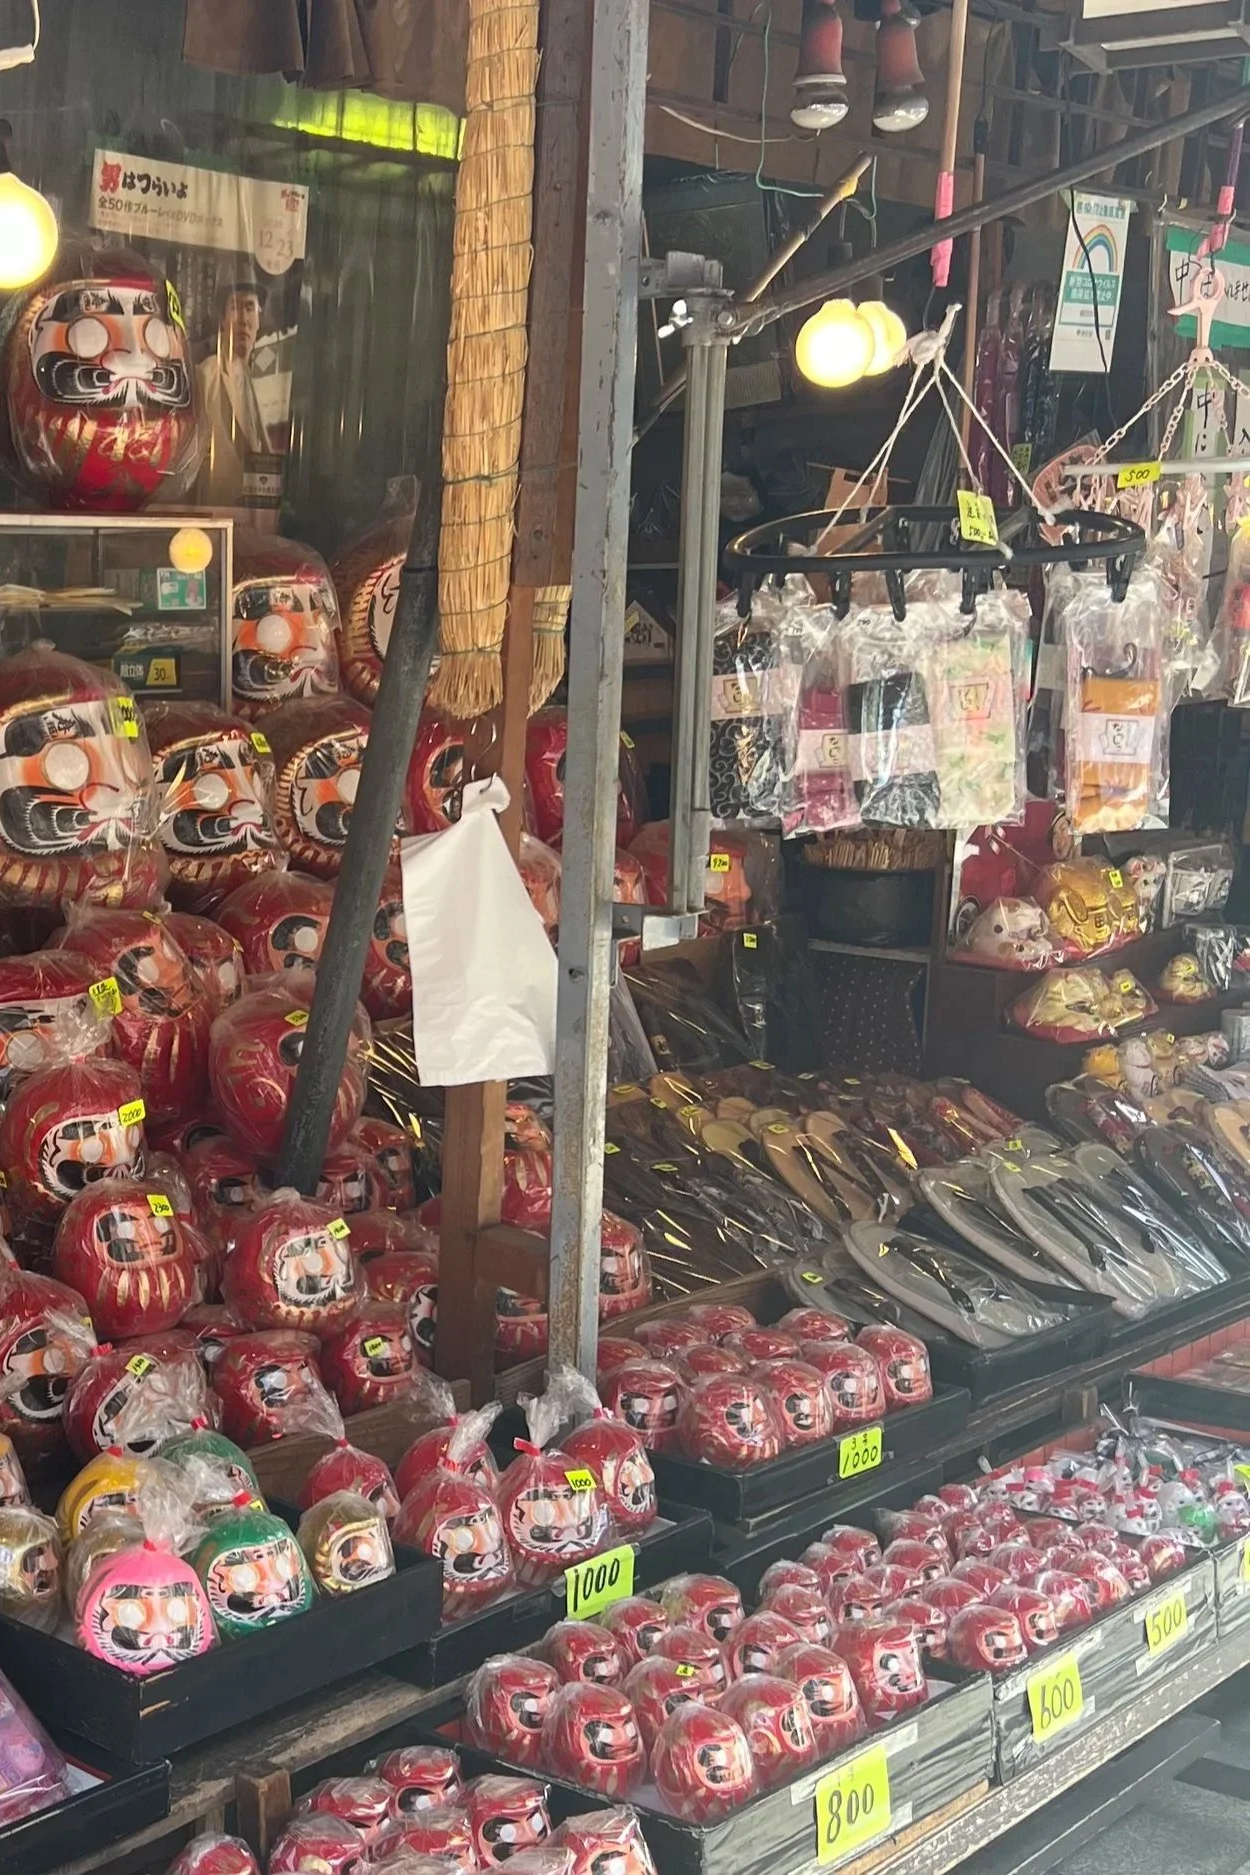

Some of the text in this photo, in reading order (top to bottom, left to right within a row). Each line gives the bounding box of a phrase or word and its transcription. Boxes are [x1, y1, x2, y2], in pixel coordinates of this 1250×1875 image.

[100, 160, 188, 199] 男はつらいよ
[1125, 469, 1150, 482] 500
[123, 1108, 141, 1121] 2000
[843, 1445, 879, 1475] 1000
[570, 1478, 591, 1488] 1000
[572, 1558, 619, 1612] 1000
[1152, 1600, 1182, 1647] 500
[1040, 1677, 1074, 1730] 600
[827, 1783, 874, 1844] 800
